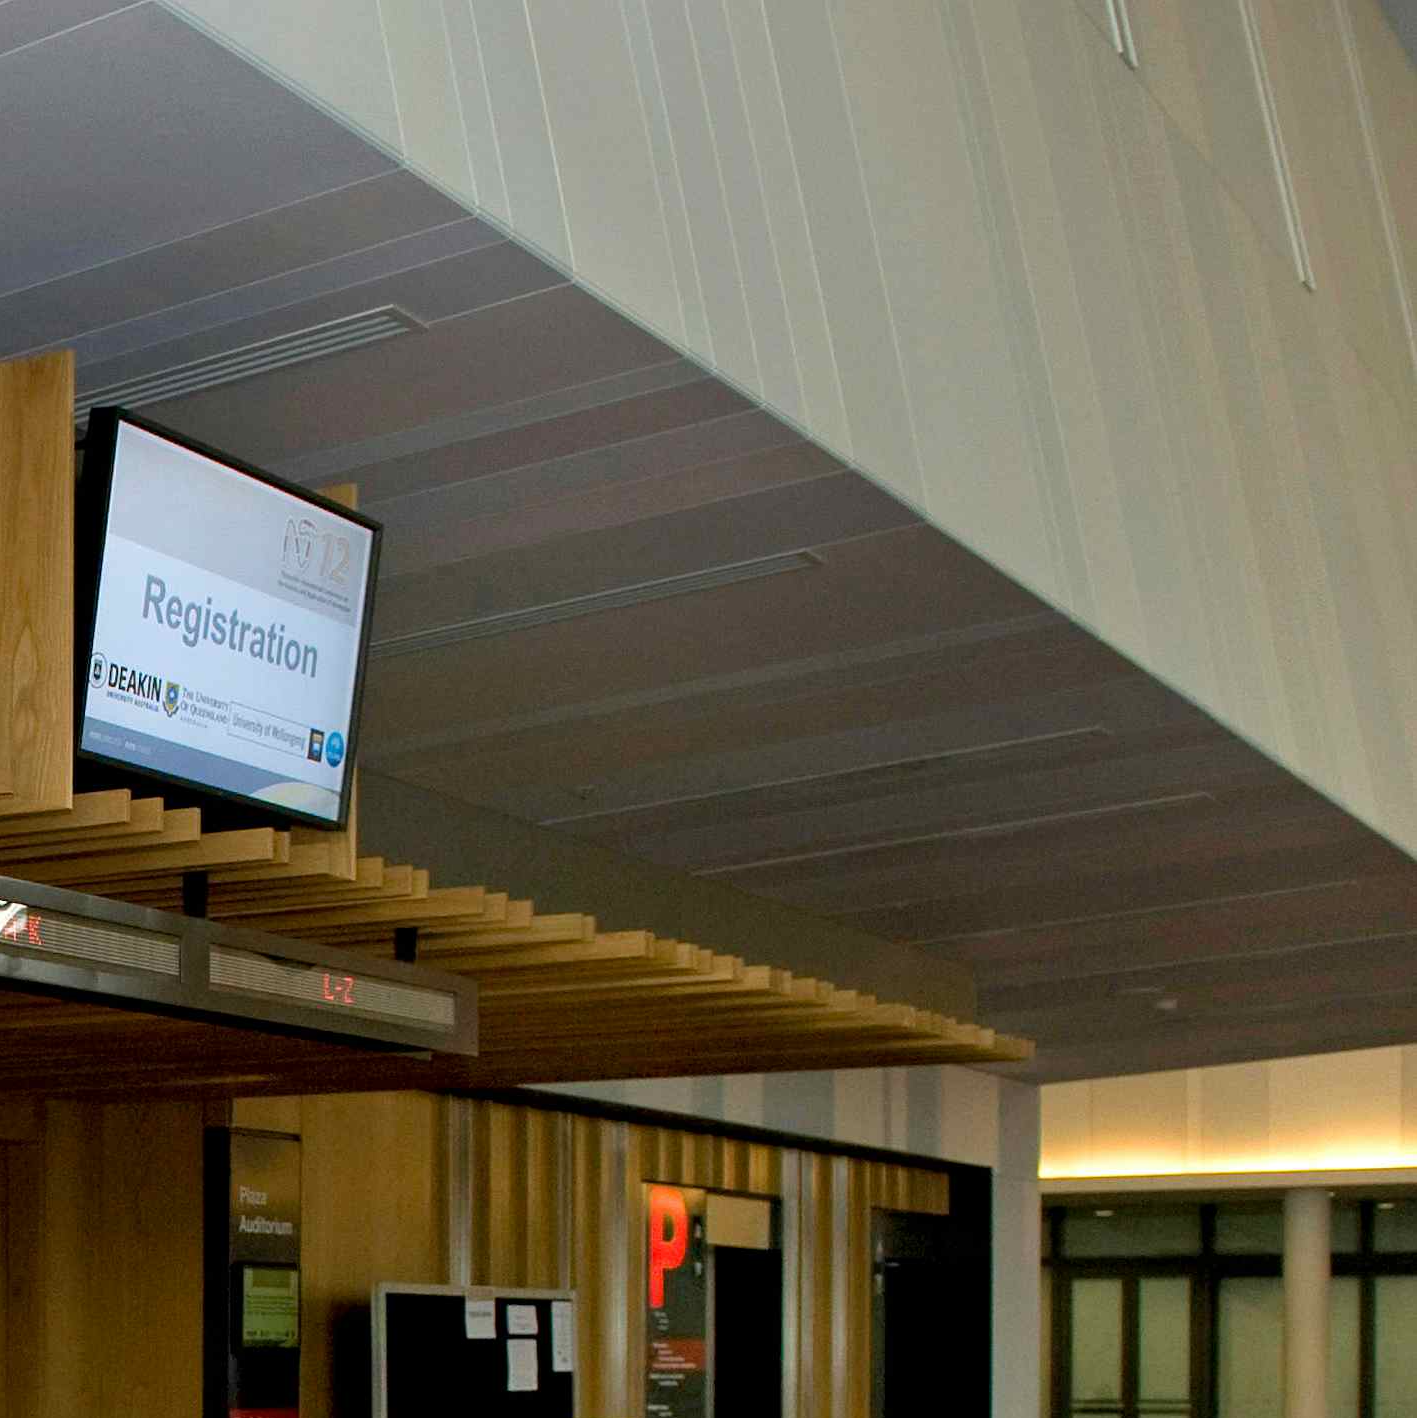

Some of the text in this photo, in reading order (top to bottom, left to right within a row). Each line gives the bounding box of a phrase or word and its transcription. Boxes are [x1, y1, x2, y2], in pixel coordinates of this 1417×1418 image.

[142, 572, 319, 679] Registration
[108, 662, 162, 703] DEAKIN
[238, 1215, 293, 1235] Auditorium
[649, 1184, 689, 1309] P
